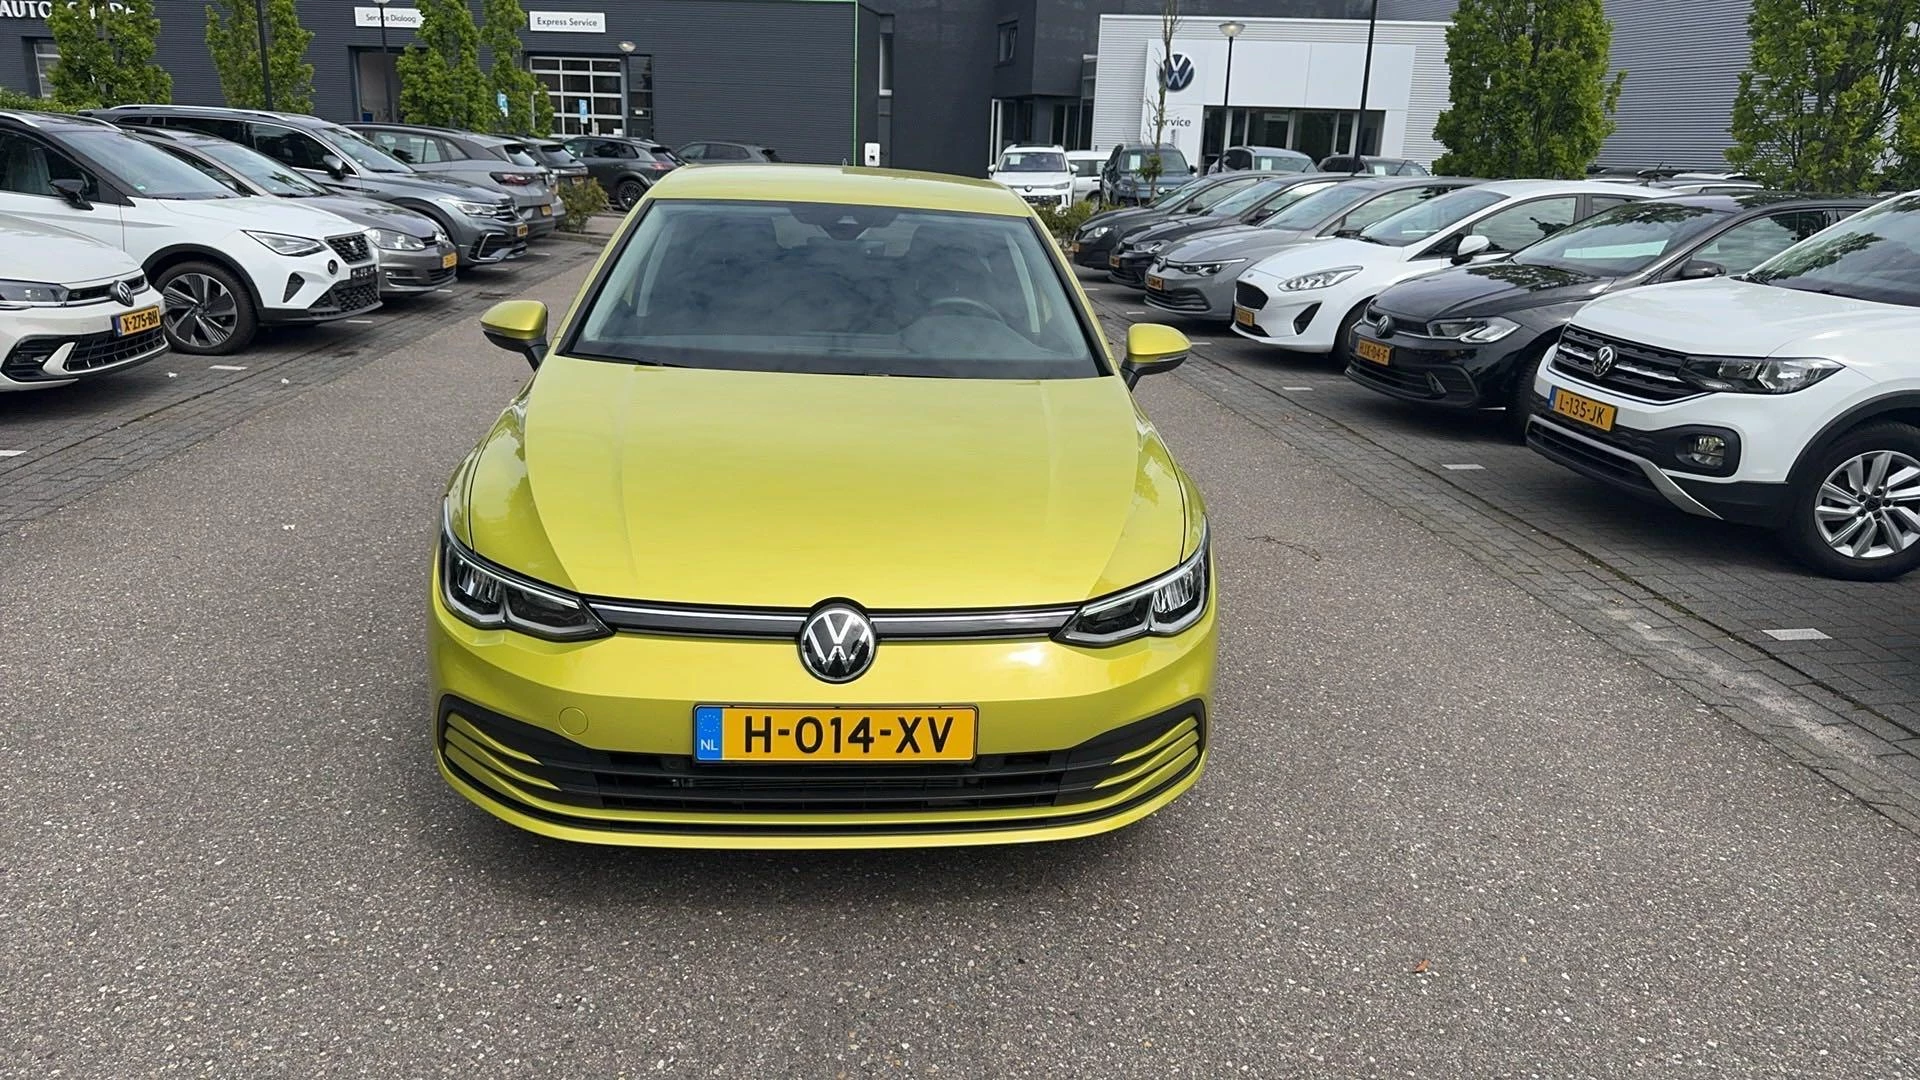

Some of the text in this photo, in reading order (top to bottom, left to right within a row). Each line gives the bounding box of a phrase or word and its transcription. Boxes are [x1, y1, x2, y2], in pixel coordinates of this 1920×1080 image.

[366, 14, 389, 22] Serve
[537, 16, 598, 27] Express Service
[1152, 116, 1191, 127] Srvice
[122, 310, 158, 333] X-275-BH
[1559, 393, 1606, 425] L-135-JK
[700, 716, 954, 754] NL H-014-XV
